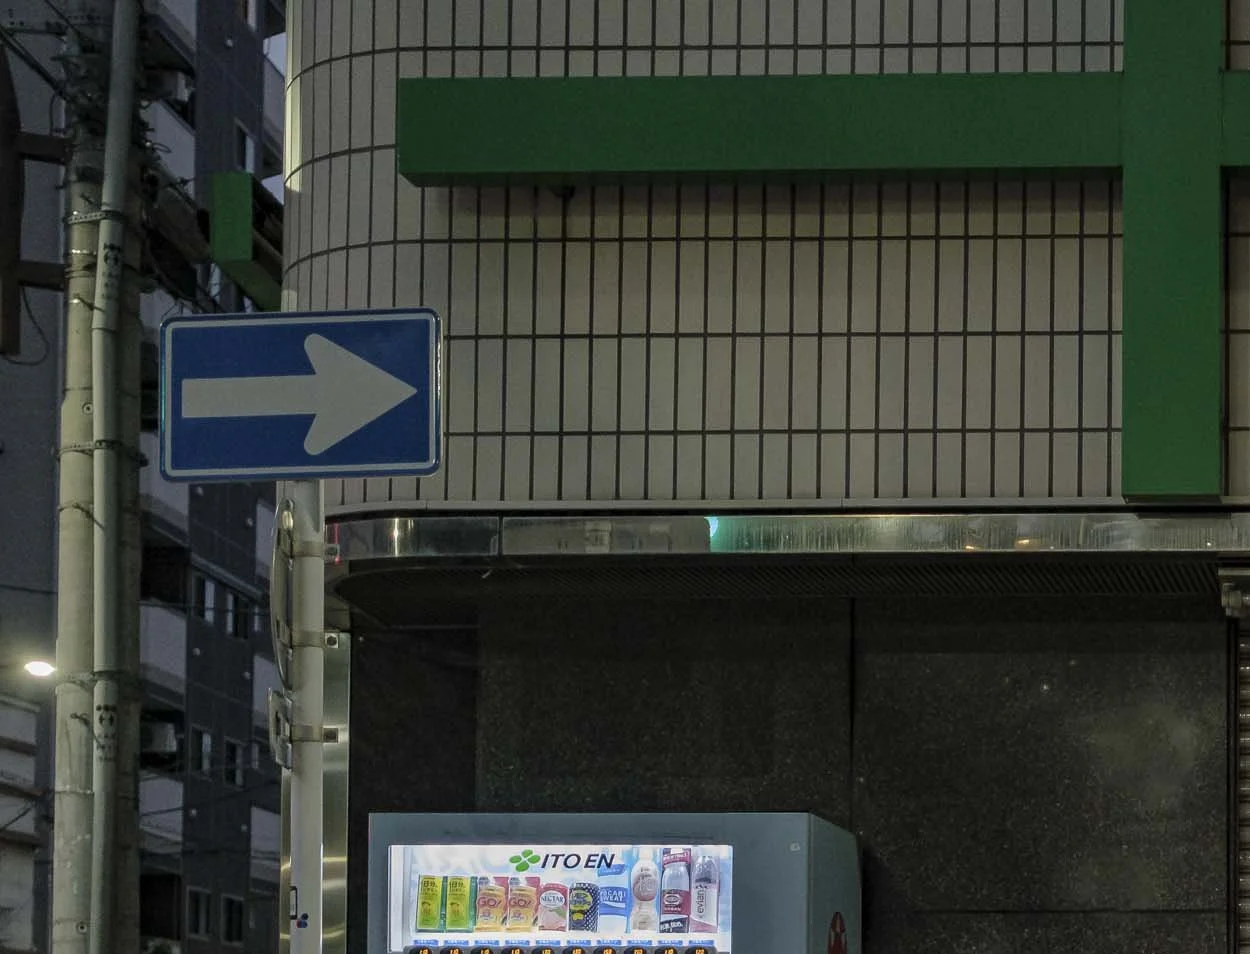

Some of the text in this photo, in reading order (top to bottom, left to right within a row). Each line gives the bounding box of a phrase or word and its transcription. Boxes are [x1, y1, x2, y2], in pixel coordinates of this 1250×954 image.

[541, 853, 615, 869] ITO EN
[696, 889, 705, 914] evian
